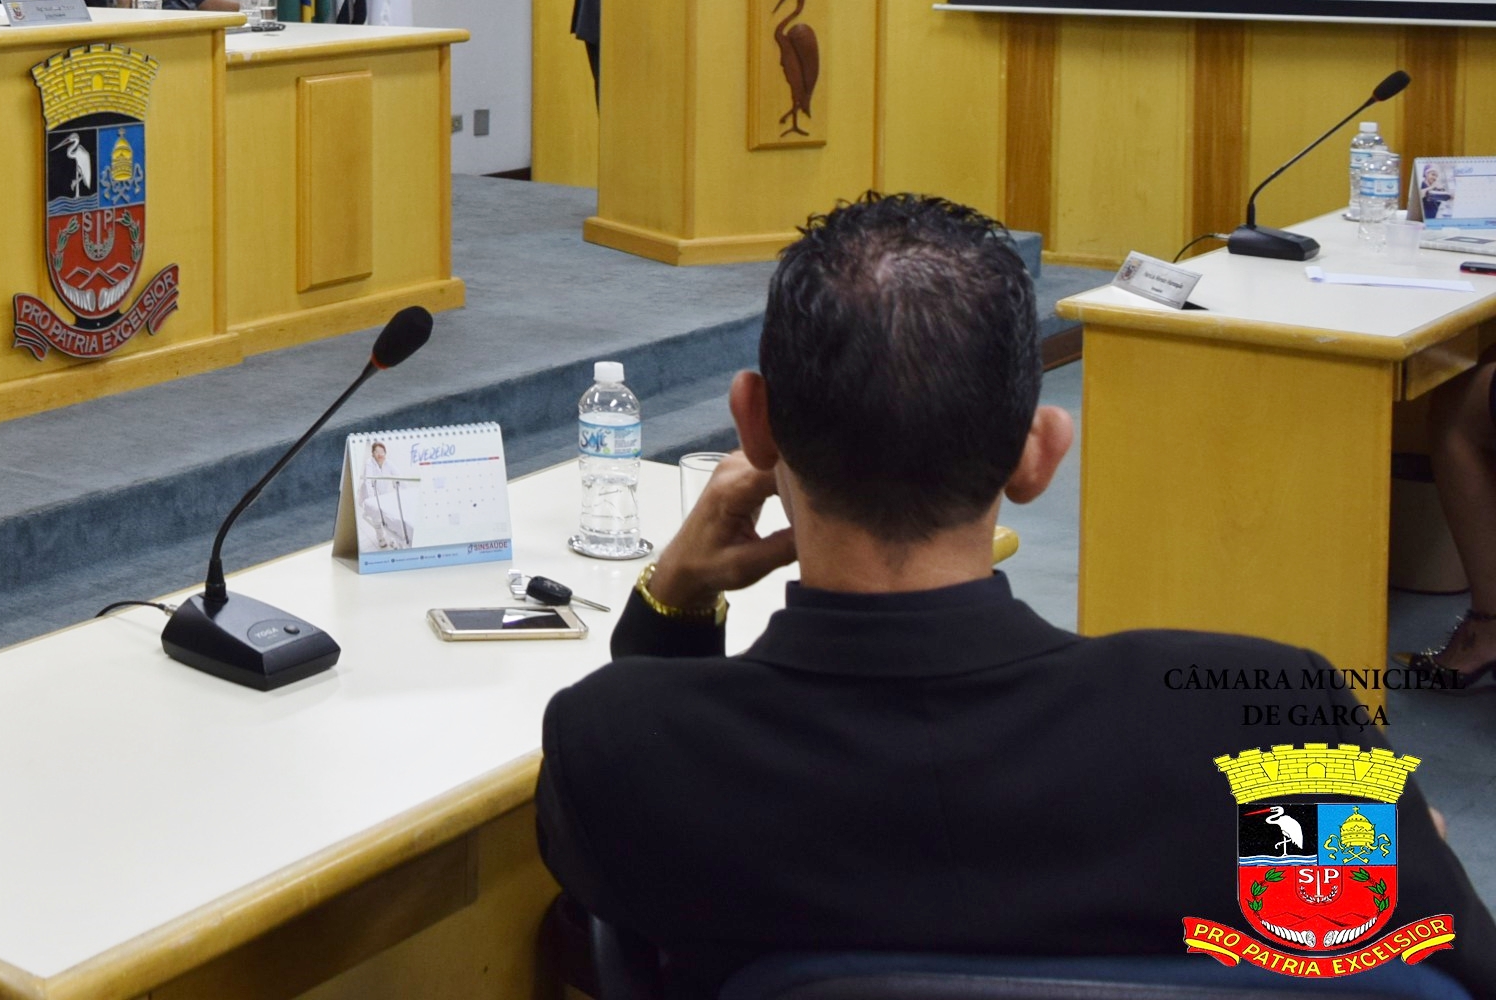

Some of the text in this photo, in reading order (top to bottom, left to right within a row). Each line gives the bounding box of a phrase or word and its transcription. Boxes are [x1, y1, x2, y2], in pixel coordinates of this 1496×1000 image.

[20, 271, 175, 354] PRO PATRIA EXCELSIOR
